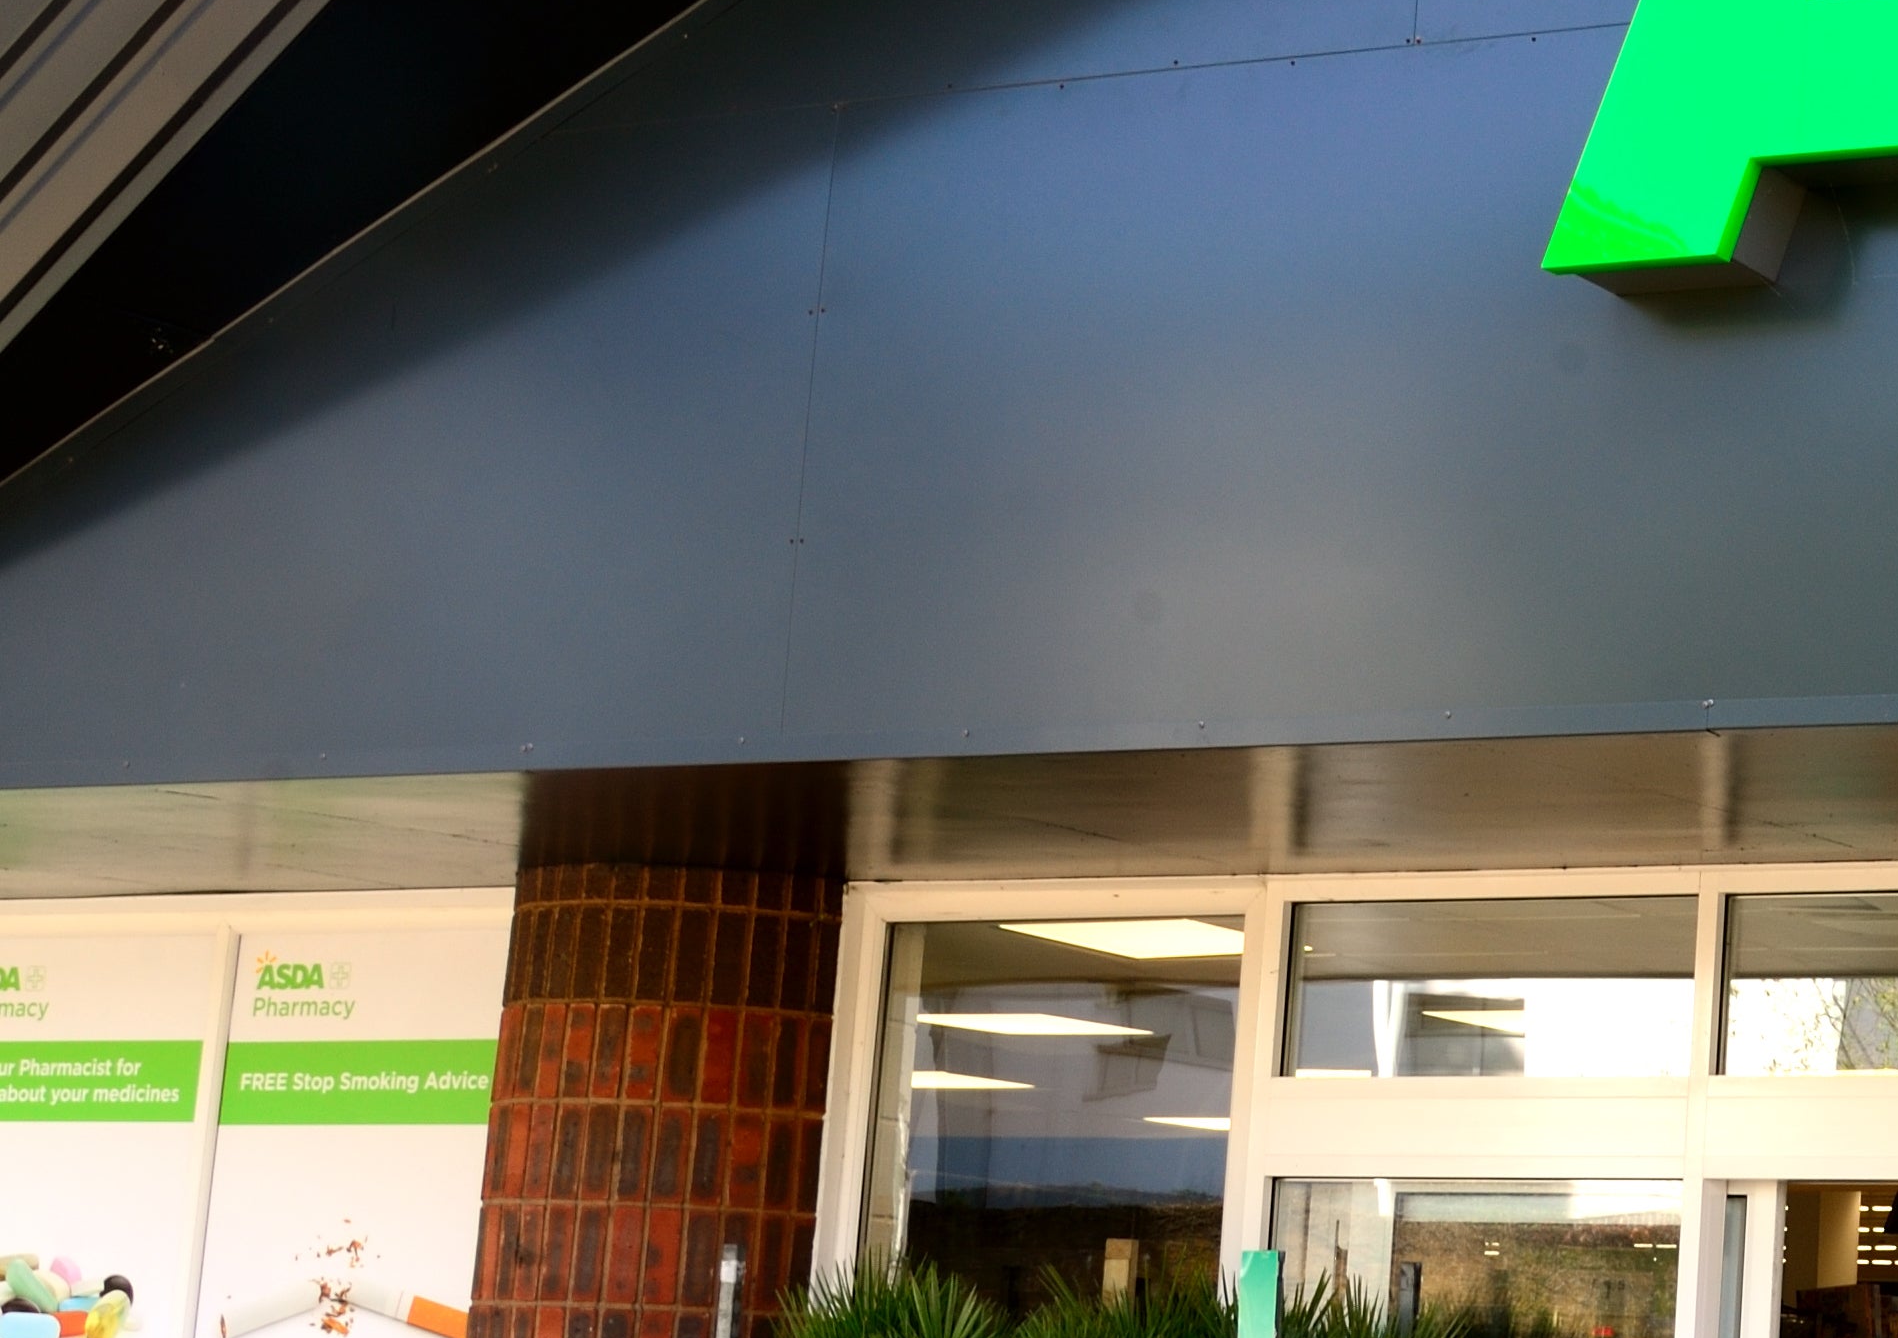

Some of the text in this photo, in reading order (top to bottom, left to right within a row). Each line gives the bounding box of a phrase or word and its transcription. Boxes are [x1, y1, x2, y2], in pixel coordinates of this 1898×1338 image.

[257, 963, 324, 989] ASDA
[0, 1001, 49, 1020] macy
[253, 997, 355, 1020] Pharmacy
[19, 1058, 111, 1077] Pharmacist
[117, 1058, 141, 1076] for
[240, 1070, 489, 1093] FREE Stop Smoking Advice
[0, 1084, 179, 1105] about your medicines
